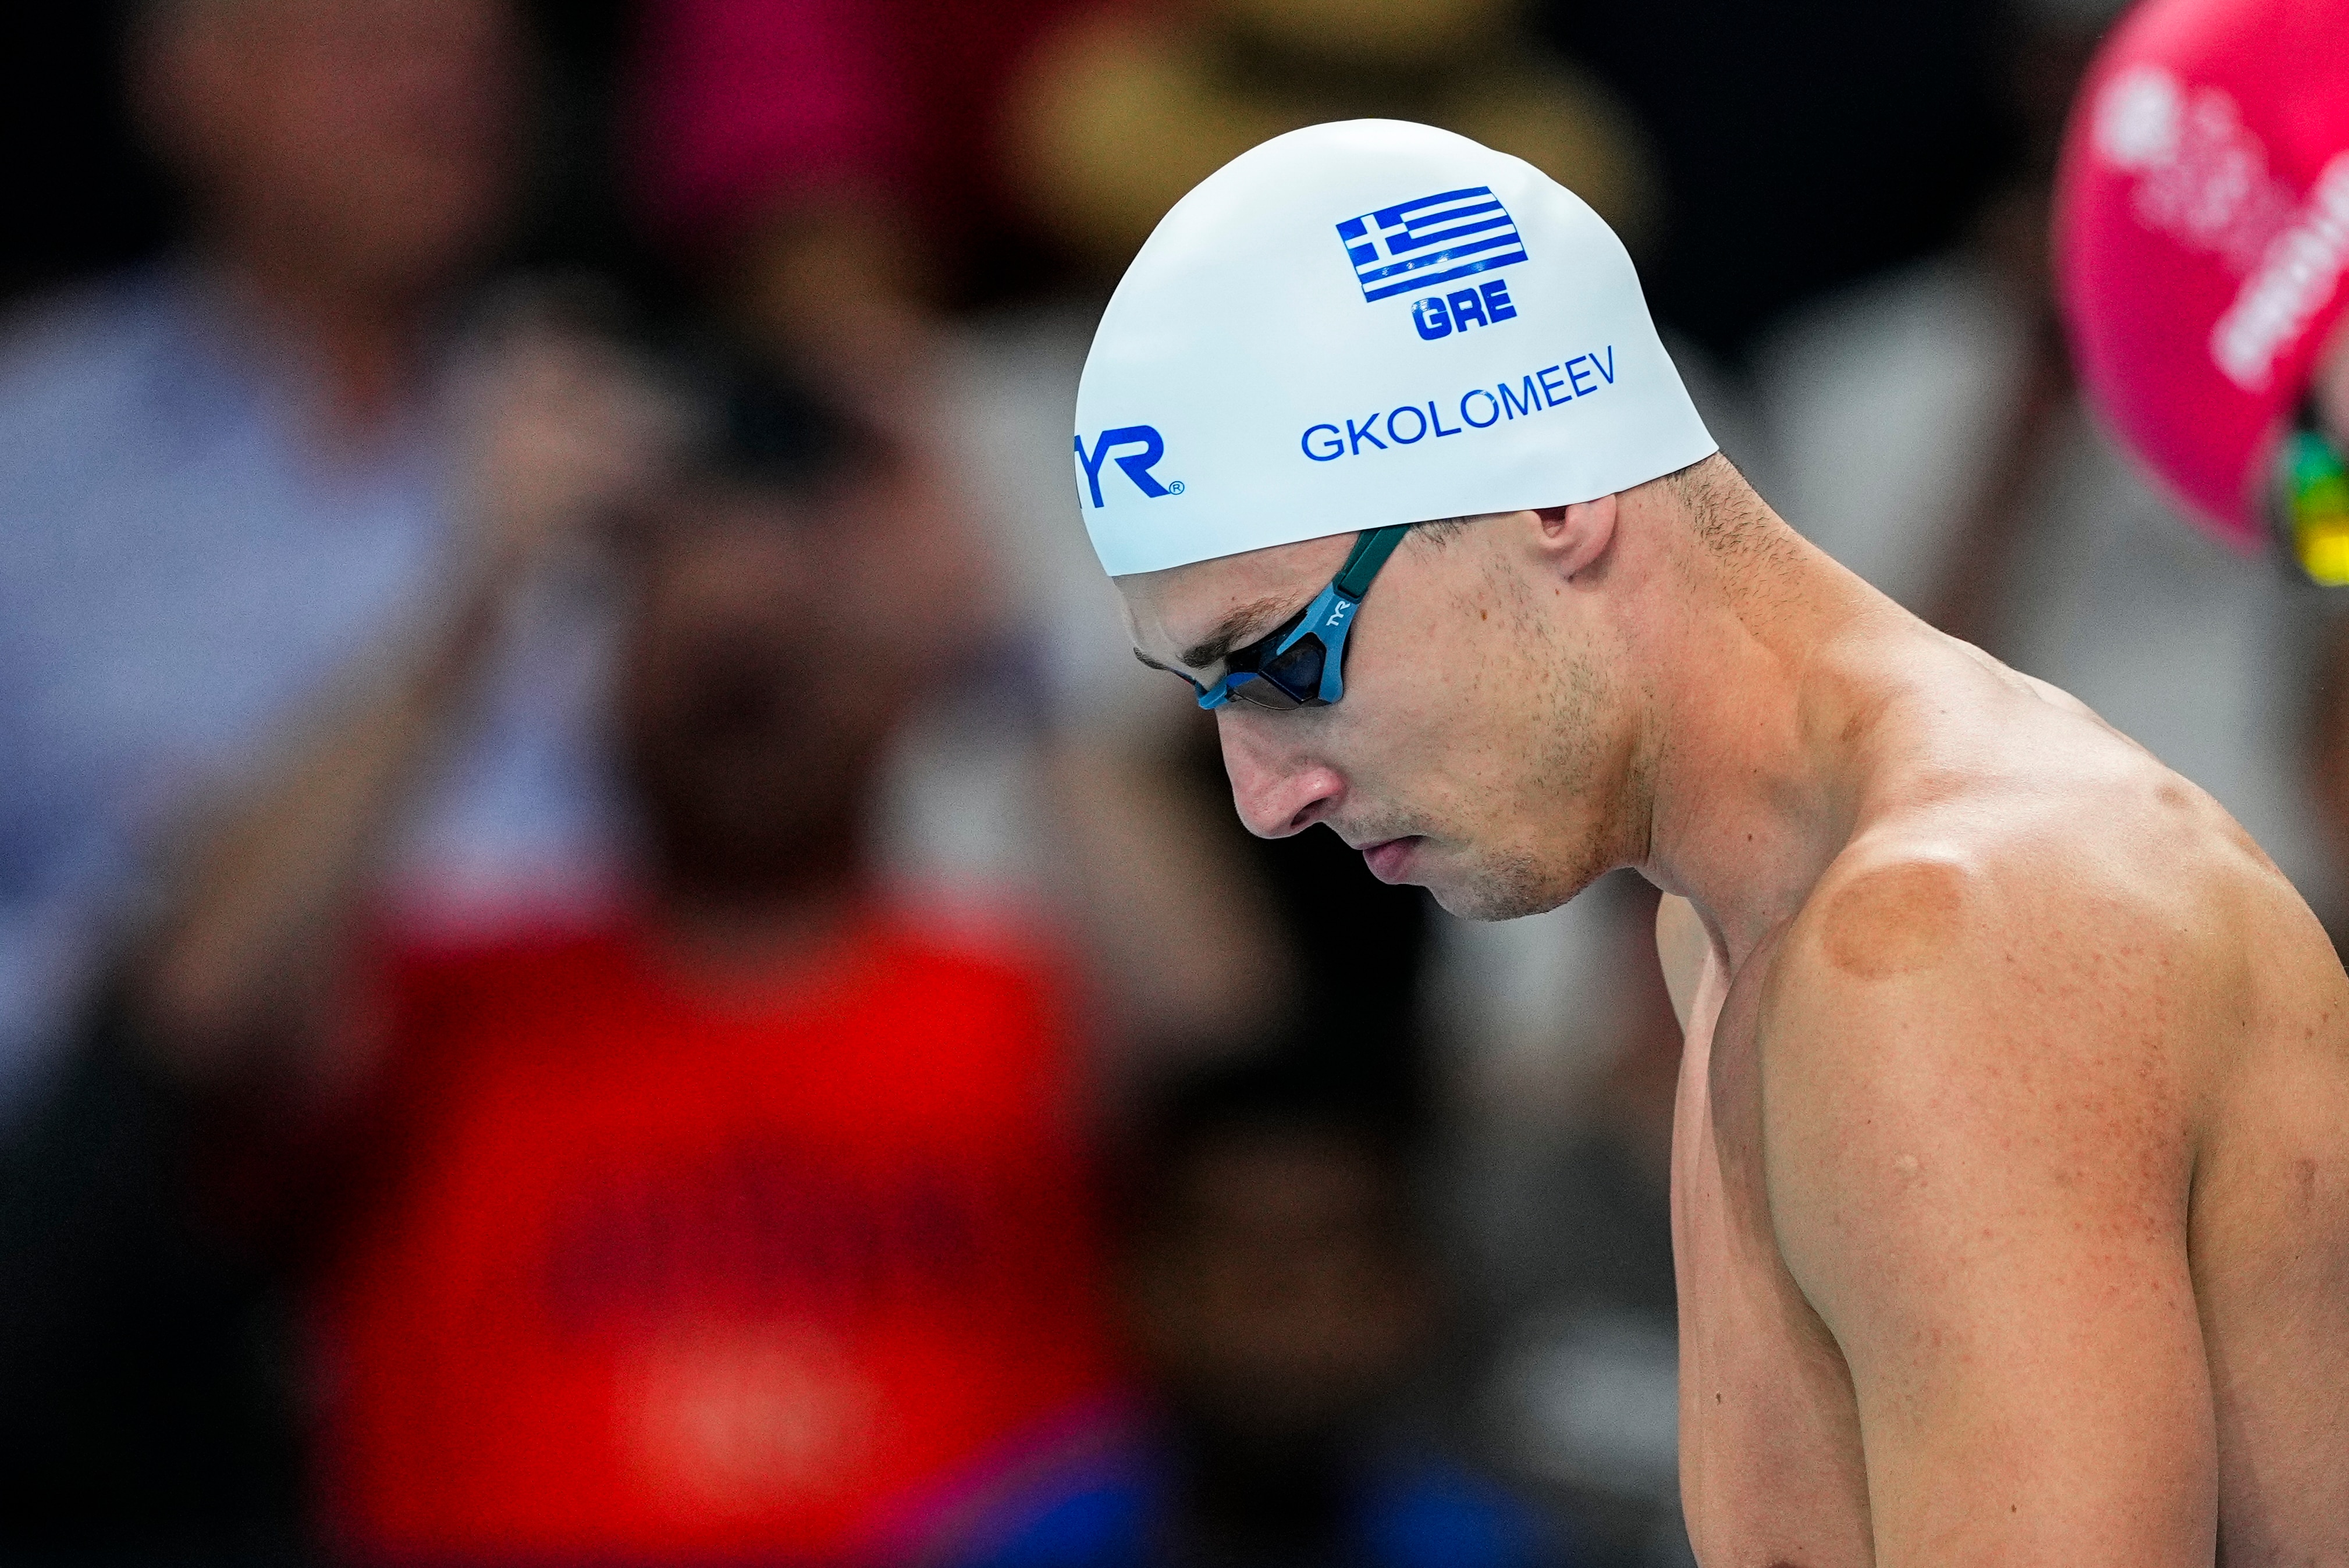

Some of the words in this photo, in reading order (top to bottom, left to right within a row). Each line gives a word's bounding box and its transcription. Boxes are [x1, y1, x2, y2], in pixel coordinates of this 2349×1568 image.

[1411, 278, 1518, 342] GRE
[1300, 345, 1616, 462] GKOLOMEEV
[1074, 424, 1171, 509] YR
[1325, 600, 1351, 626] TYR
